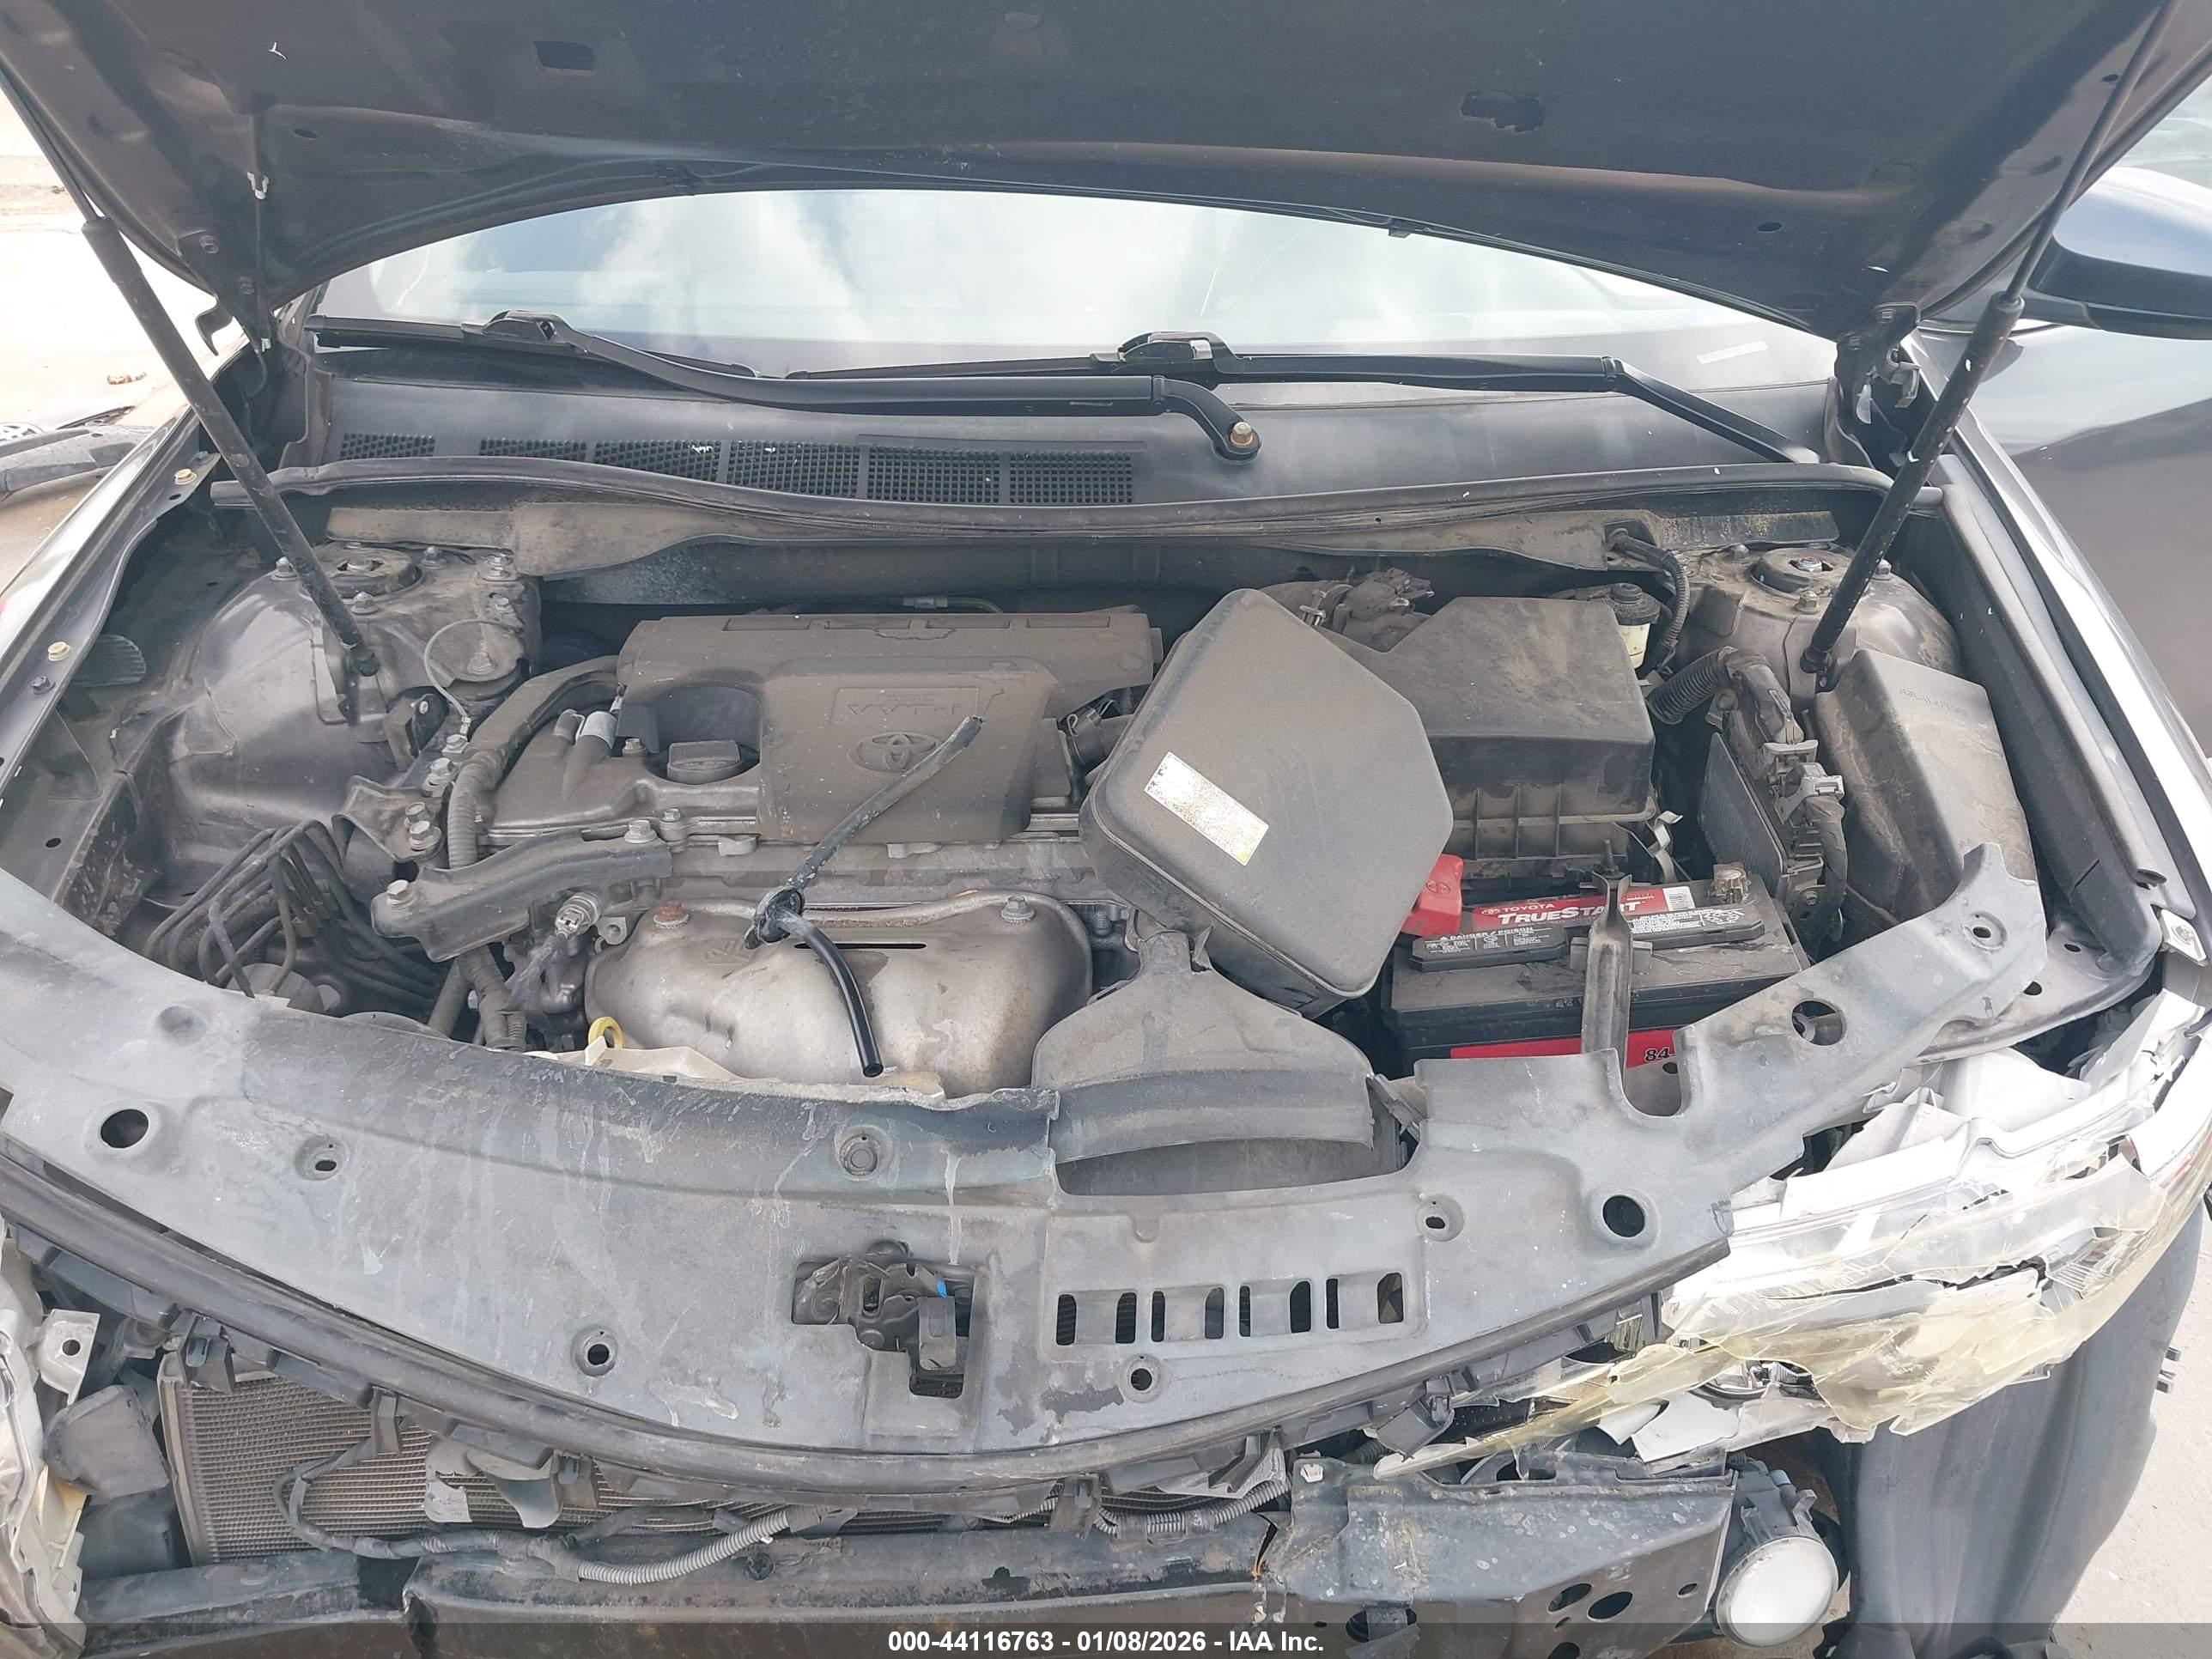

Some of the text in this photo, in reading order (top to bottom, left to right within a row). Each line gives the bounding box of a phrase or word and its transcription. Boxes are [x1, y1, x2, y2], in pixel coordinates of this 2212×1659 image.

[1502, 903, 1555, 913] TOYOTA
[1449, 932, 1489, 940] DANGER
[1498, 927, 1534, 935] POISON
